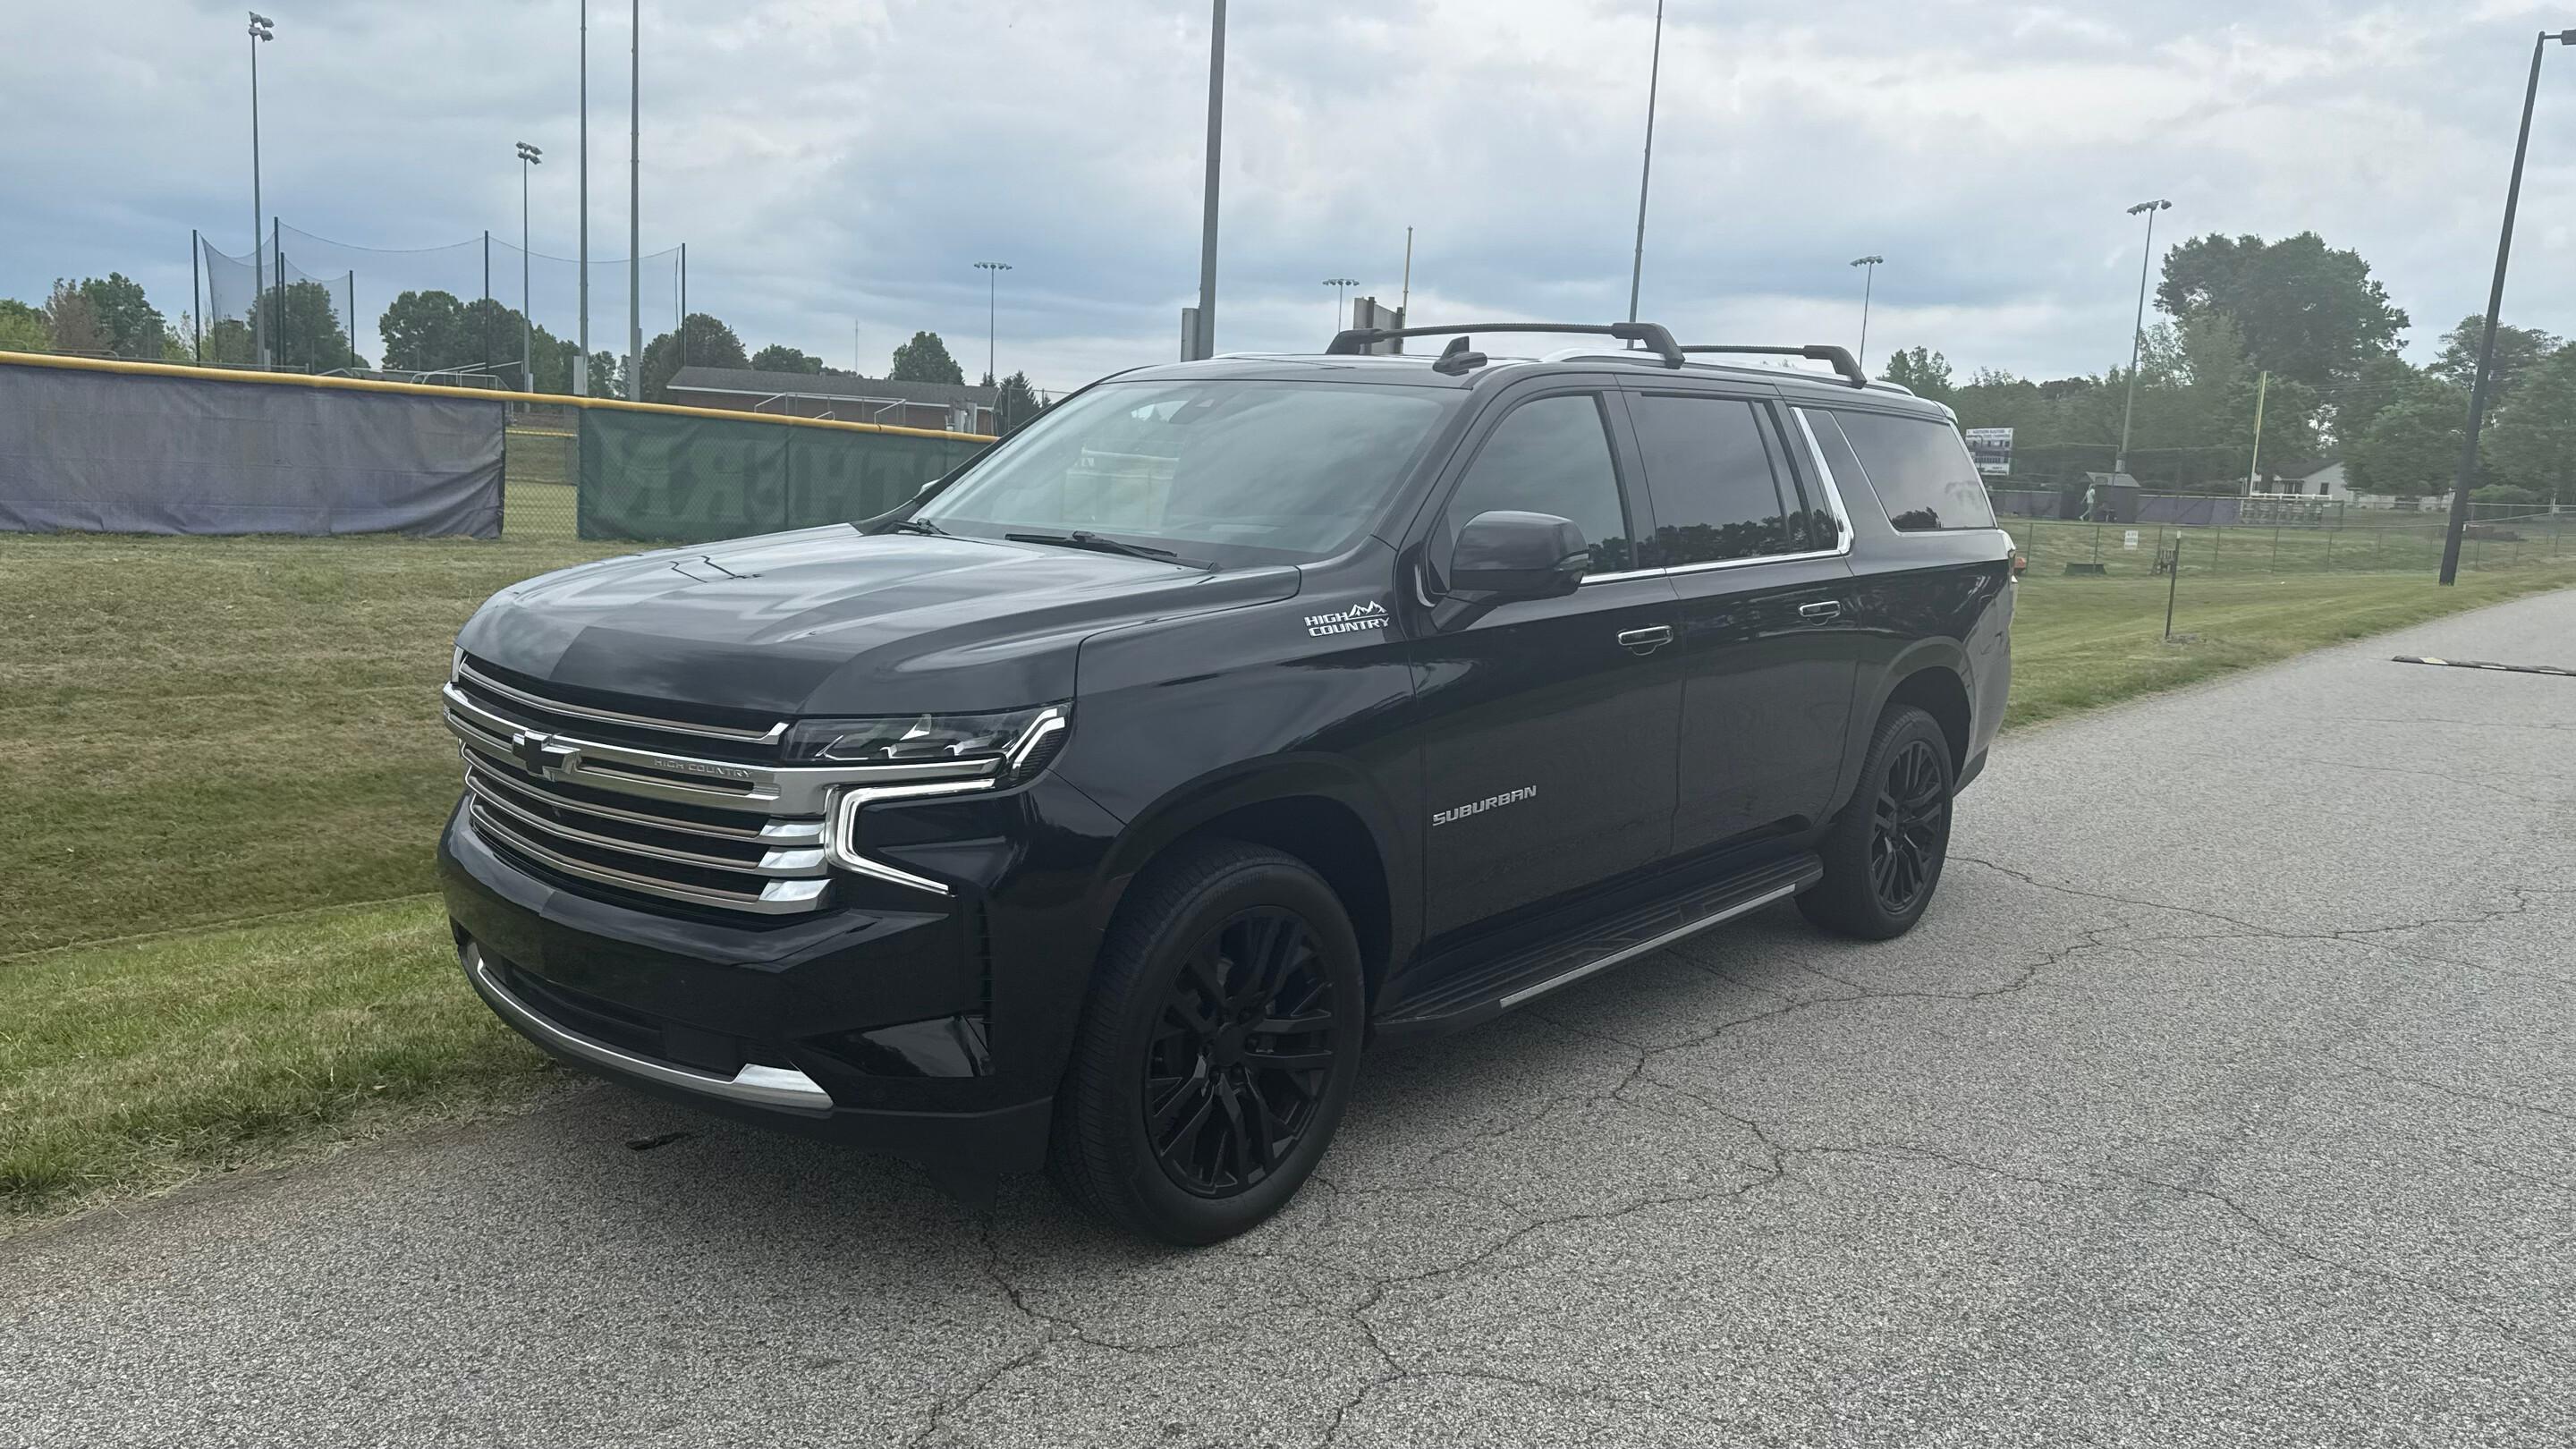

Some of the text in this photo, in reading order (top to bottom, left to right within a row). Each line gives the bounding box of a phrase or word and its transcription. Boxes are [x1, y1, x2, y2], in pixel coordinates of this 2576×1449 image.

[1304, 612, 1349, 626] HIGH
[1308, 617, 1390, 637] COUNTRY
[654, 758, 753, 778] HIGH COUNTRY
[1432, 784, 1537, 826] SUBURBAN
